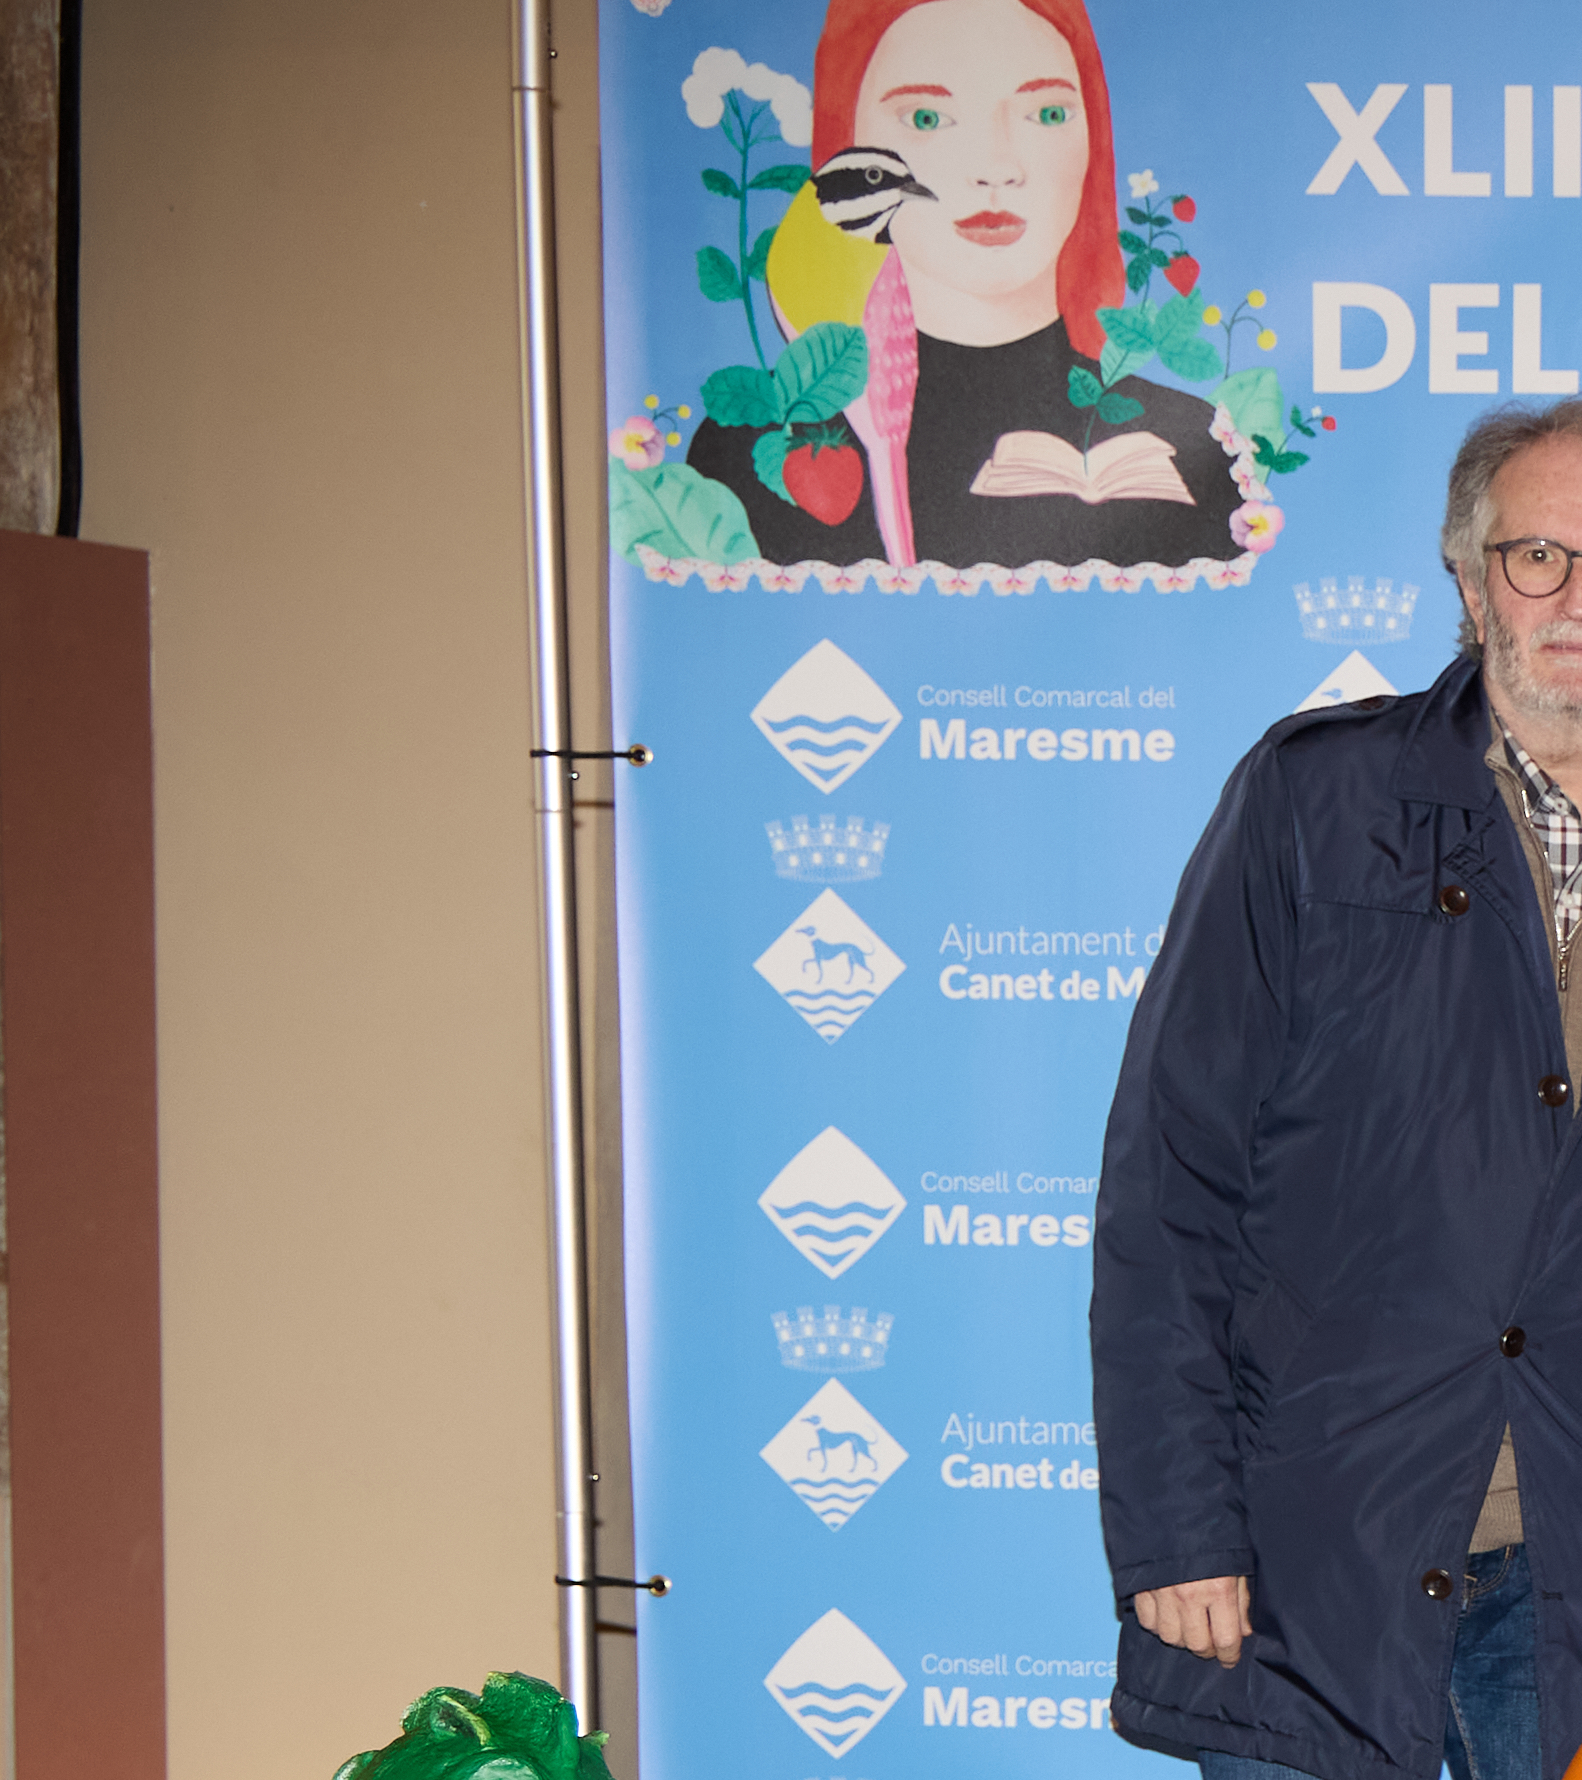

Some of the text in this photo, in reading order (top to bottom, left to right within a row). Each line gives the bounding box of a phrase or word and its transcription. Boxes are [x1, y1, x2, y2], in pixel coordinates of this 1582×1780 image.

[1304, 82, 1582, 198] XLII
[1311, 281, 1579, 395] DEL
[917, 685, 1176, 708] Consell Comarcal del
[918, 718, 1176, 762] Maresme
[939, 922, 1136, 962] Ajuntament
[939, 964, 1054, 1000] Canet
[1059, 970, 1101, 1001] de
[920, 1171, 1009, 1193] Consell
[941, 1453, 1099, 1490] Canet de
[921, 1653, 1009, 1676] Consell
